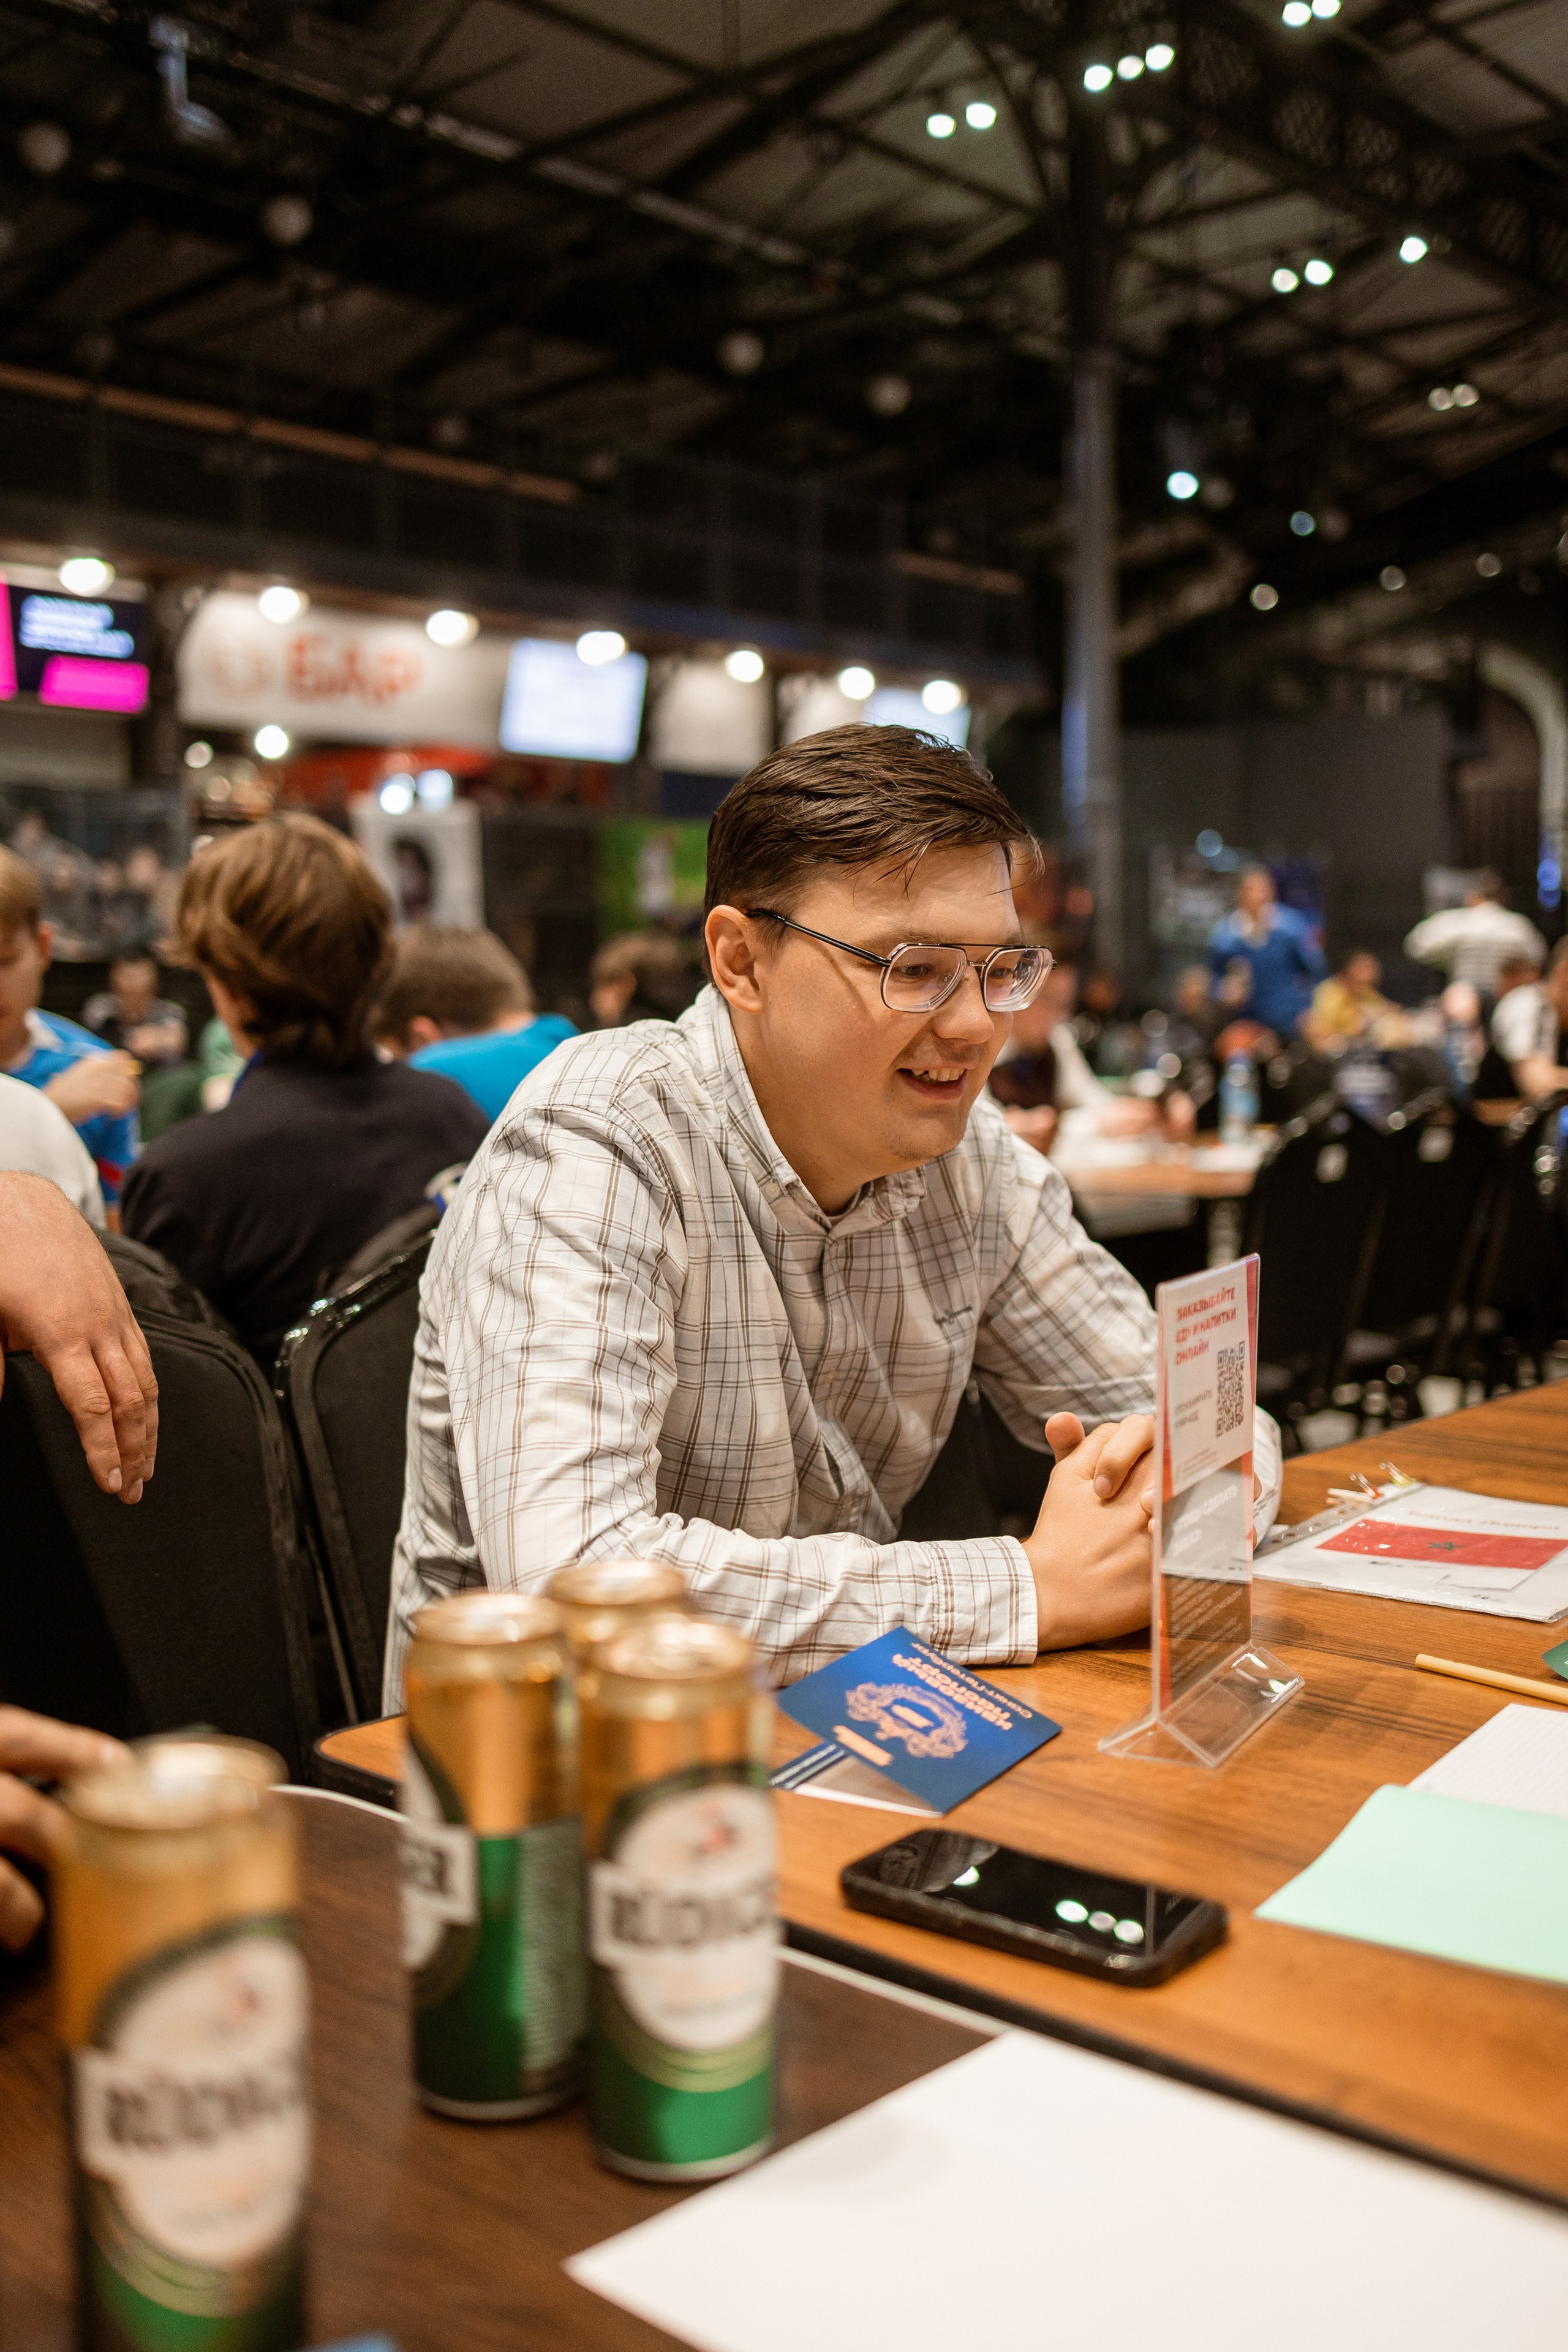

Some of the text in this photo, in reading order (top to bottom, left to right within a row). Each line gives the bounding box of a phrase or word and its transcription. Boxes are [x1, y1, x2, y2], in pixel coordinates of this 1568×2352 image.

[287, 635, 422, 705] БАР
[1177, 1287, 1235, 1321] ЗАКАЗЫВАЙТЕ
[1176, 1327, 1189, 1343] ЕДУ
[1200, 1307, 1236, 1332] НАПИТКИ
[1175, 1338, 1209, 1366] ОНЛАЙН
[911, 1642, 1033, 1719] Санкт-Петербург
